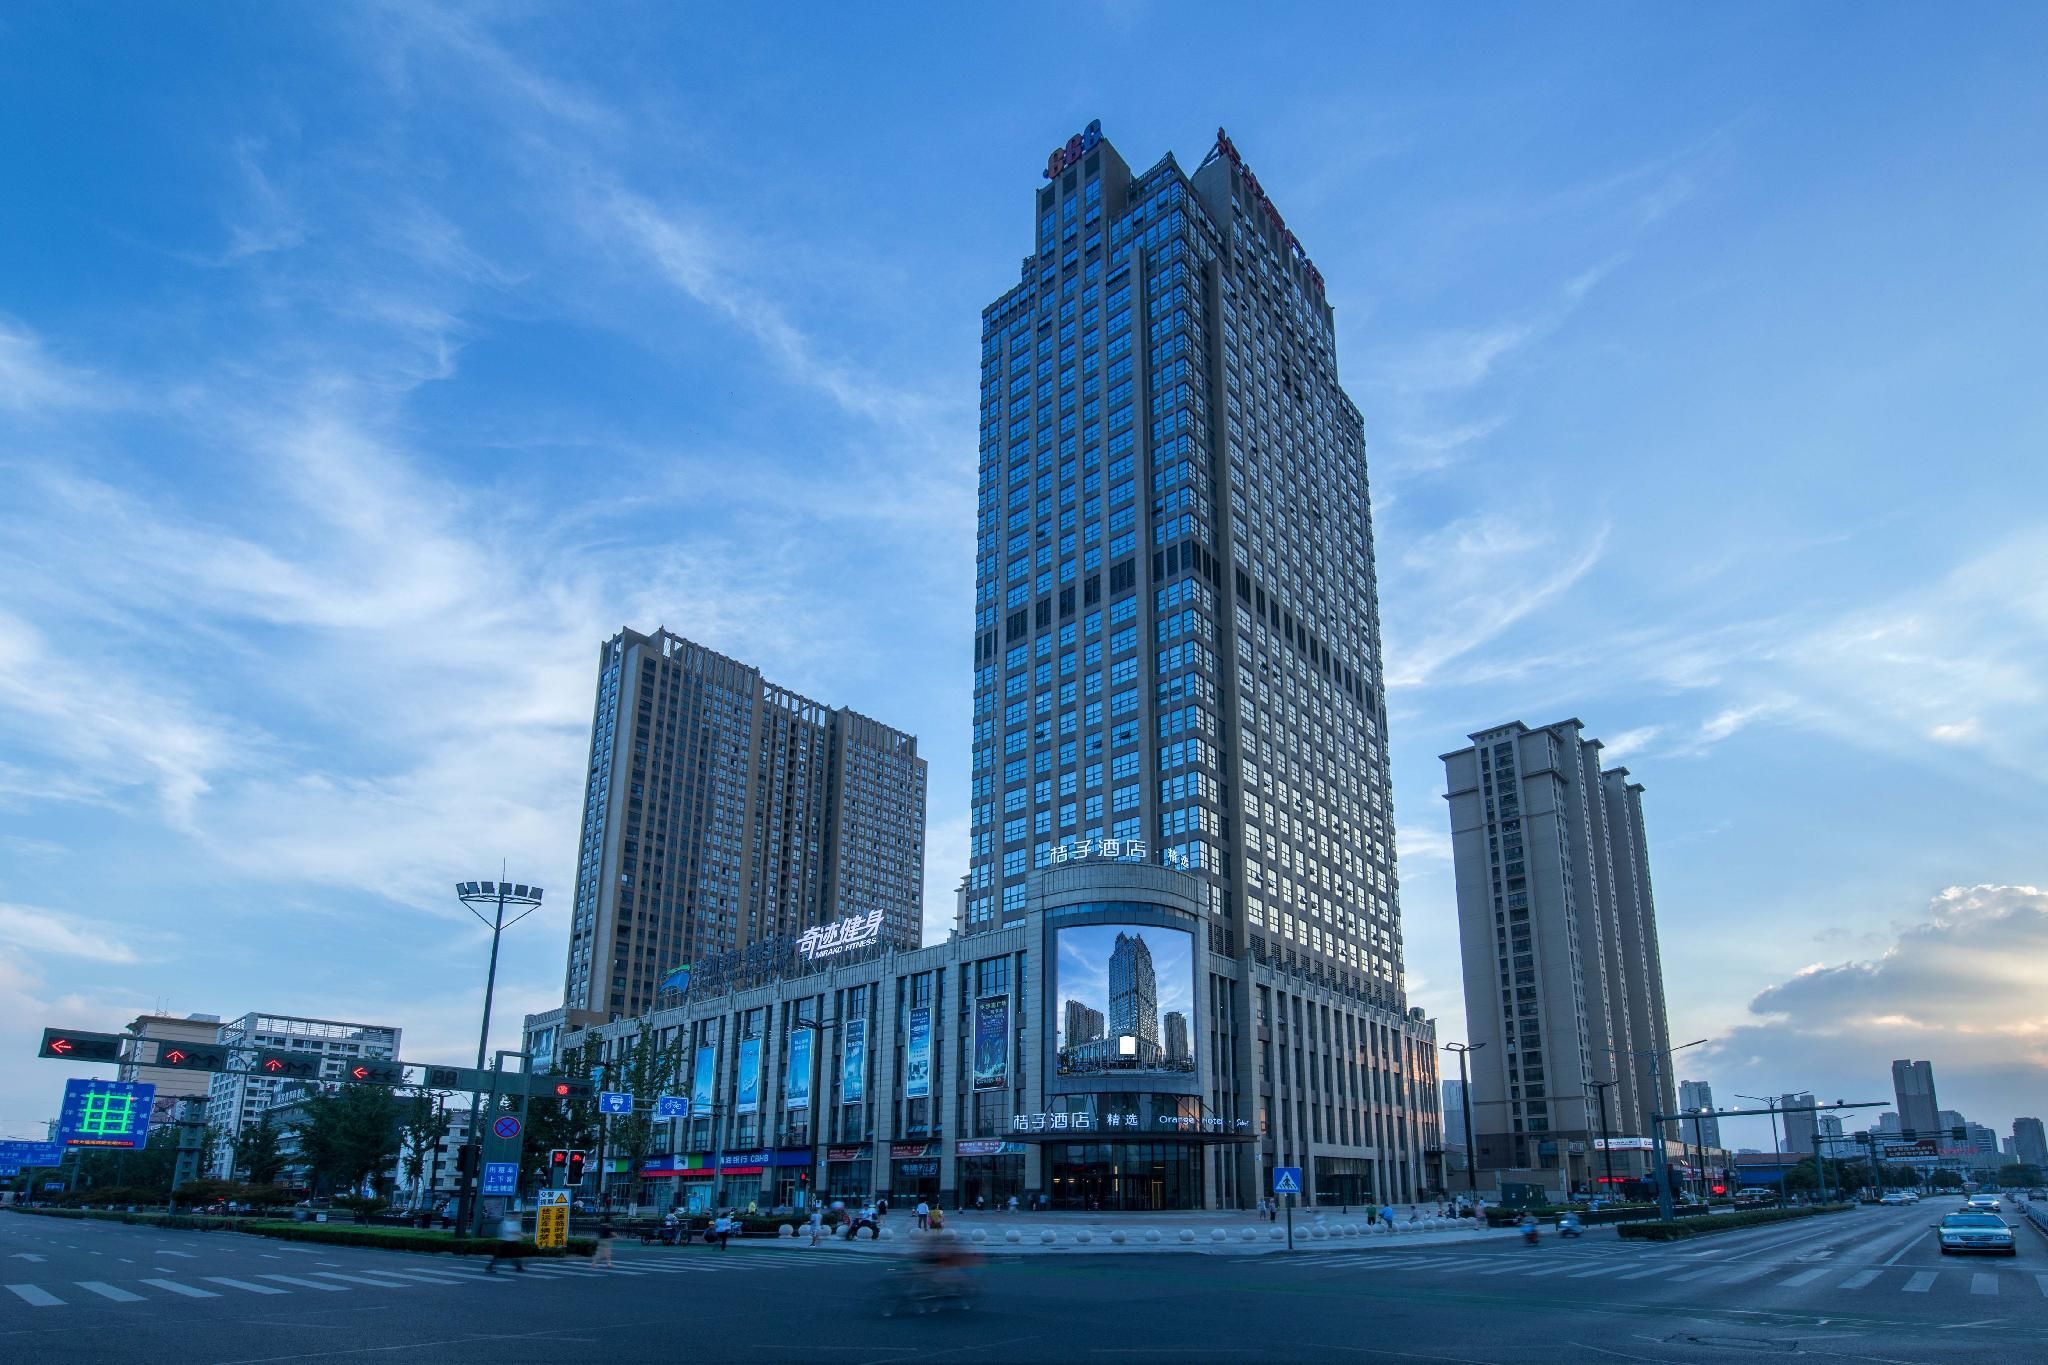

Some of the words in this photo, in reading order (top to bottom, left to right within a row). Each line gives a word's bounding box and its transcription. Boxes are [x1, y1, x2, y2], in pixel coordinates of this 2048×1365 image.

[1050, 838, 1147, 864] 桔子酒店
[1167, 847, 1189, 869] 精选
[796, 909, 884, 960] 奇迹健身
[845, 937, 877, 951] FITNESS
[1013, 1111, 1090, 1130] 桔子酒店
[1106, 1112, 1138, 1126] 精选
[1159, 1115, 1194, 1126] Orange
[1201, 1117, 1223, 1125] Hotel
[489, 1166, 514, 1174] 出租车
